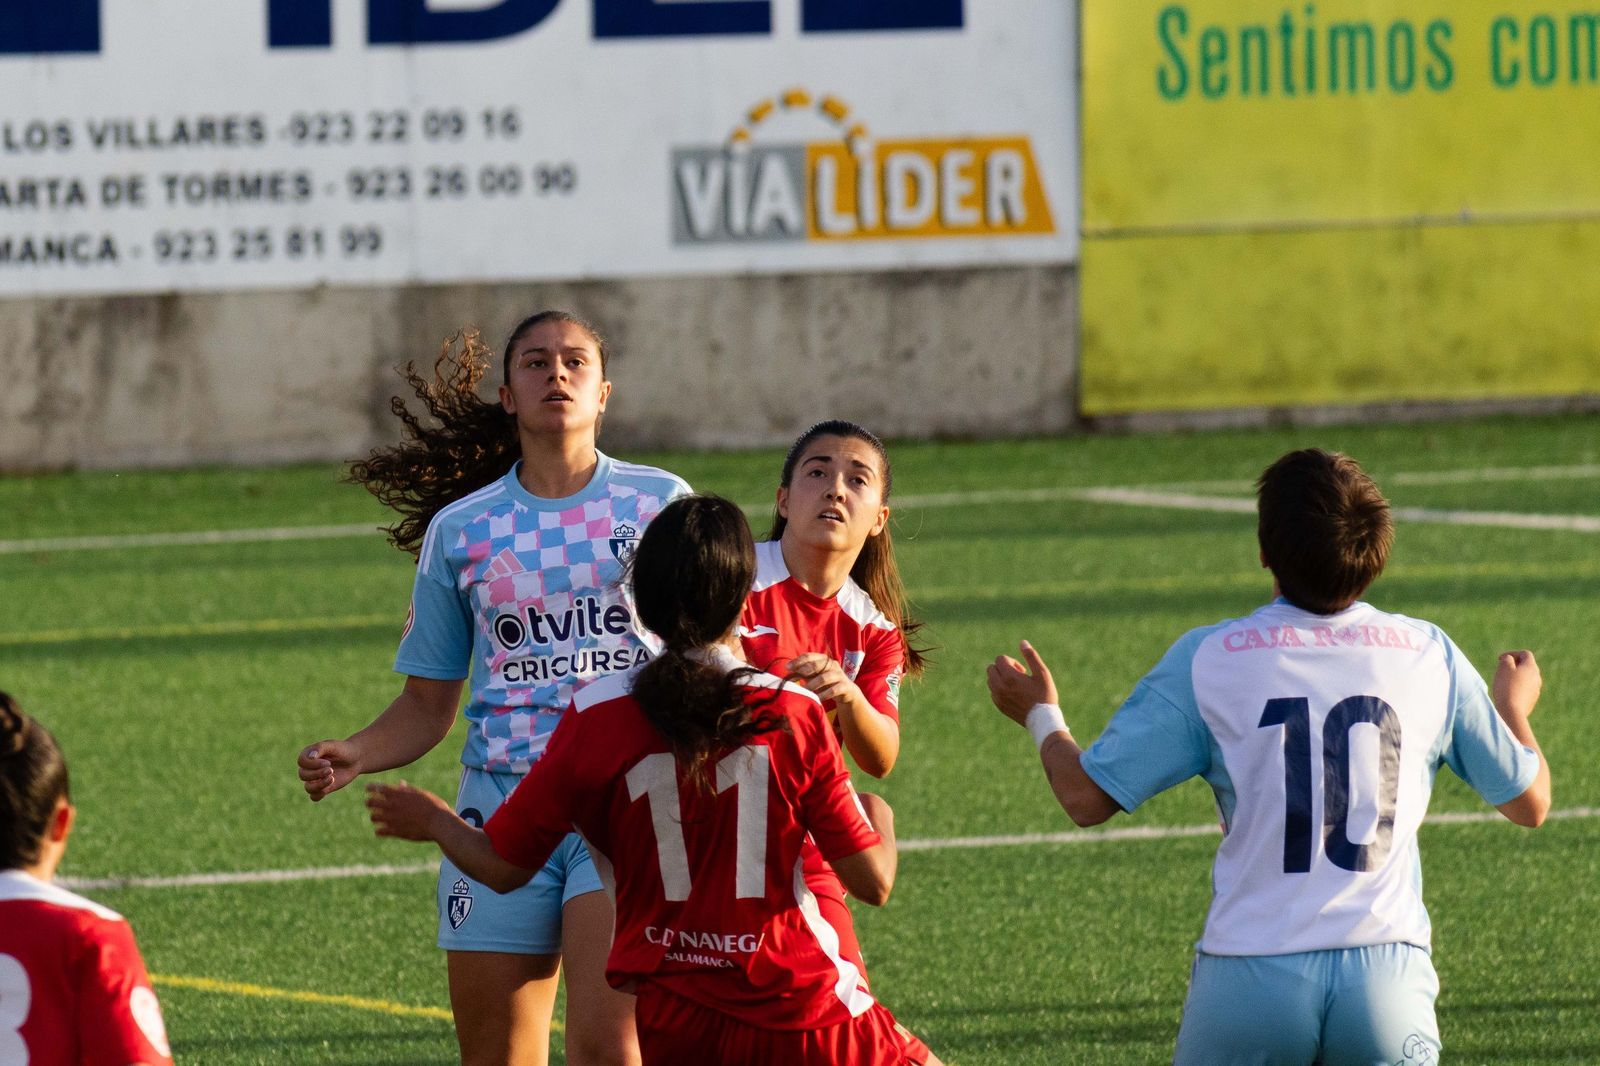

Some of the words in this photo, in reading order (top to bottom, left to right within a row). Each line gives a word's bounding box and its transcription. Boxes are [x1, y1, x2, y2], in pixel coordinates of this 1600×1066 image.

[1156, 3, 1455, 101] Sentimos
[3, 121, 74, 153] LOS
[87, 115, 267, 150] VILLARES
[367, 109, 410, 143] 22
[100, 174, 146, 207] DE
[161, 169, 313, 205] TORMES
[346, 166, 413, 201] 923
[424, 165, 469, 200] 26
[154, 230, 218, 265] 923
[231, 227, 273, 262] 25
[527, 597, 640, 643] tvite
[1223, 624, 1306, 652] CAJA
[1257, 695, 1403, 873] 10
[625, 745, 769, 901] 11
[664, 952, 734, 968] SALAMANCA
[679, 930, 765, 953] NAVEG
